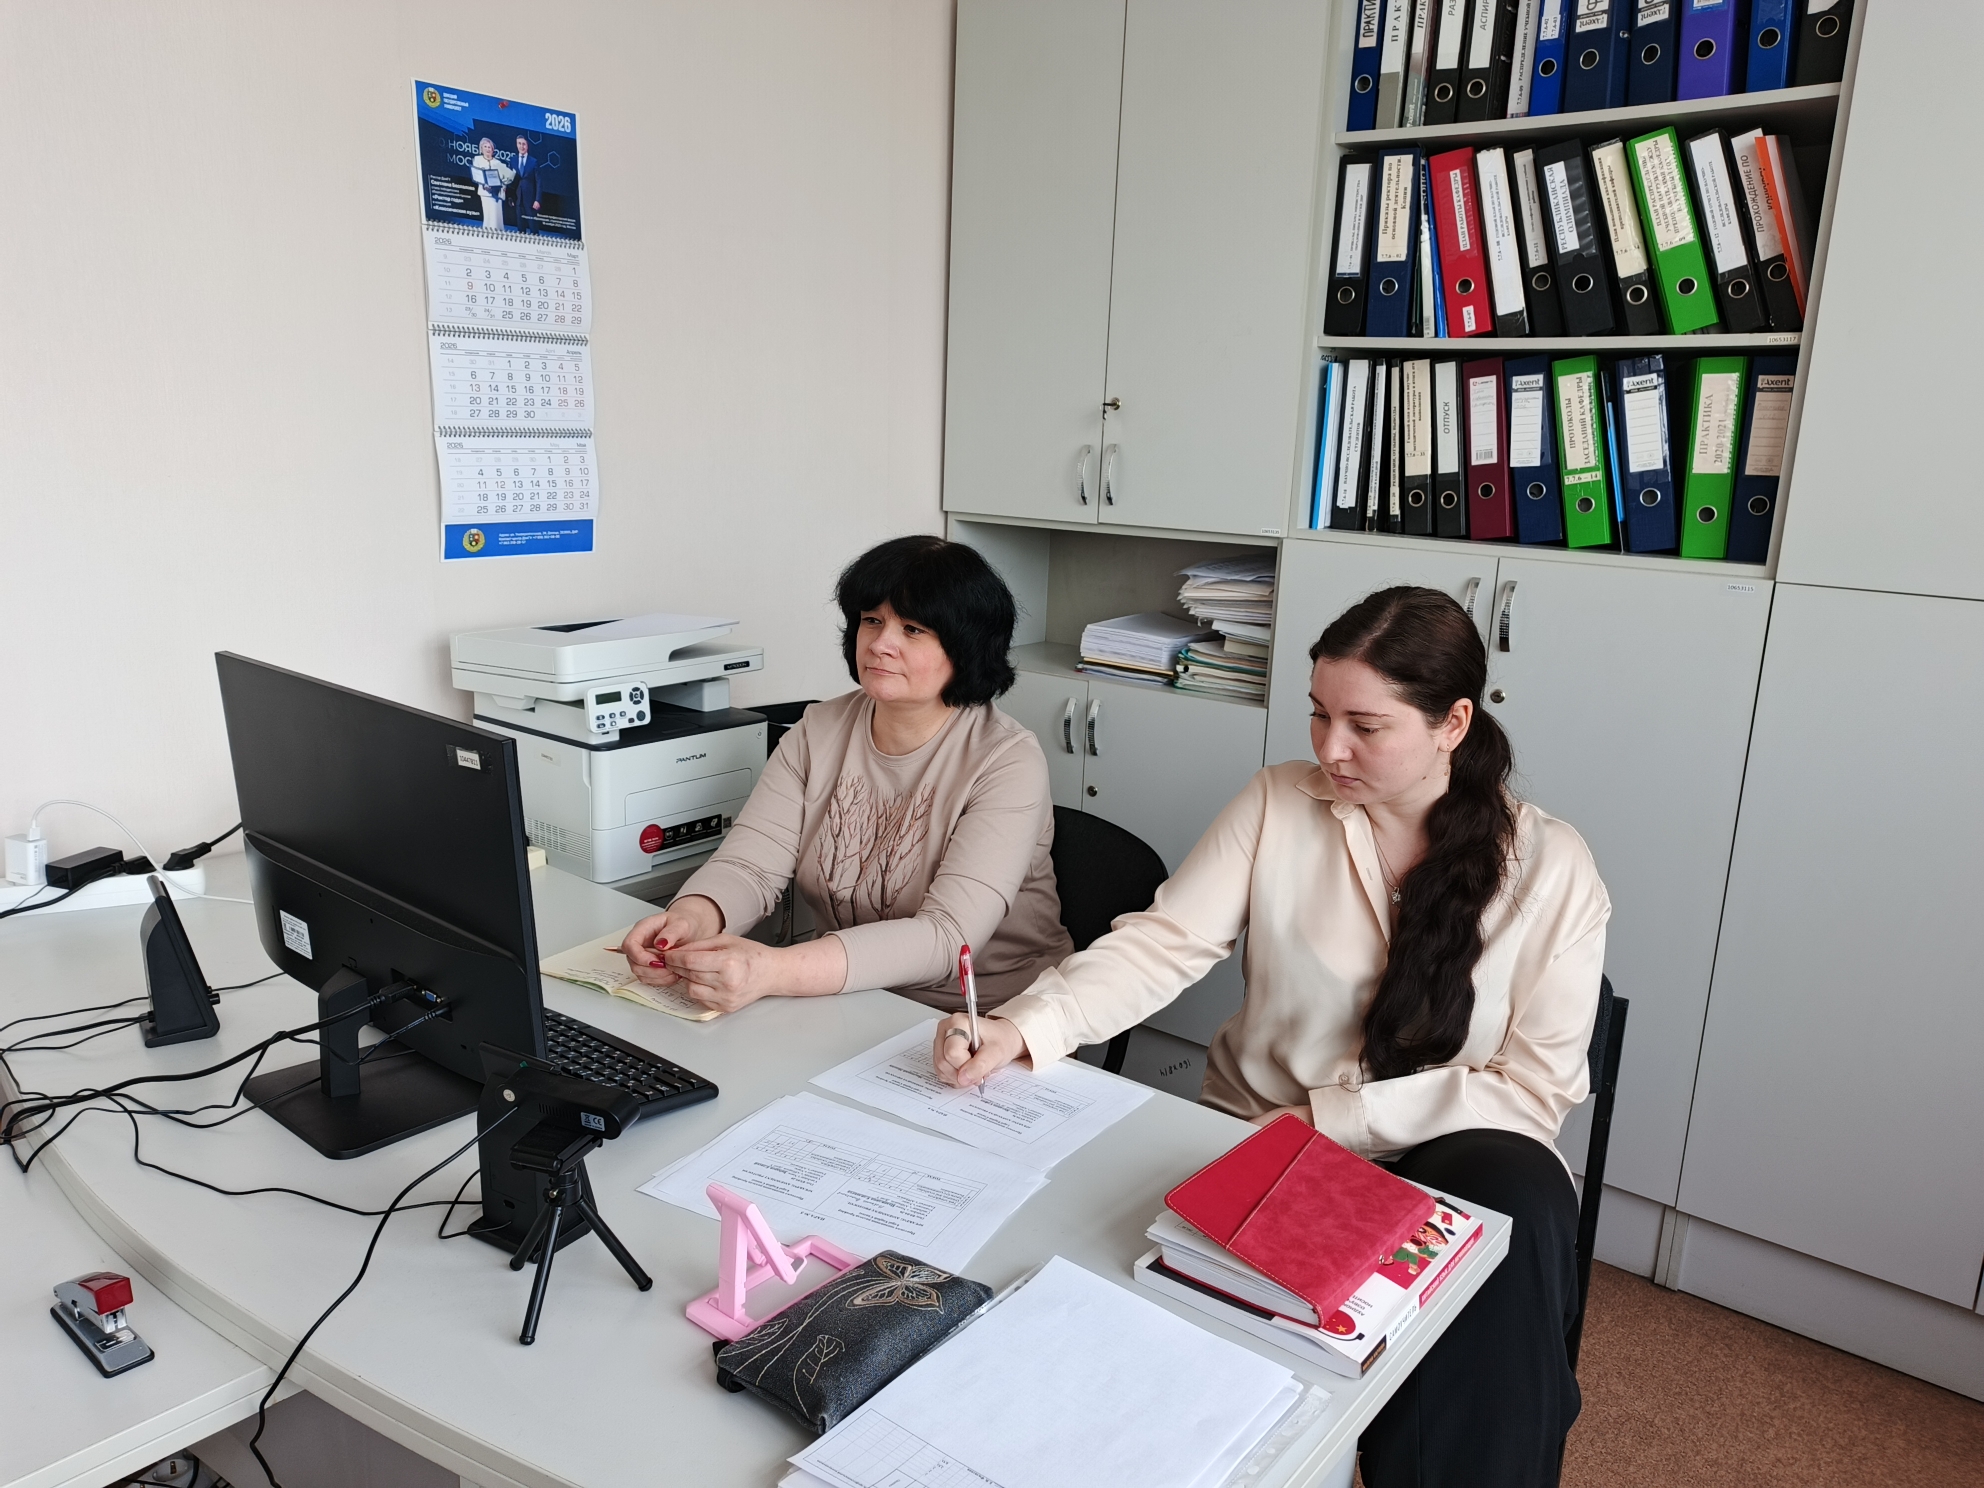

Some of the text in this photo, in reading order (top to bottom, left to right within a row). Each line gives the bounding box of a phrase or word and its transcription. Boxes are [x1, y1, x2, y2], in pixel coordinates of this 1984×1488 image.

[1519, 32, 1528, 81] РАСПРЕДЕЛЕНИЕ
[545, 113, 571, 132] 2026
[448, 139, 481, 155] НОЯБ
[1388, 163, 1392, 171] по
[1453, 173, 1462, 204] КАФЕДРЫ
[1741, 155, 1764, 232] ПРОХОЖДЕНИЕ ПО
[1457, 205, 1465, 230] РАБОТЫ
[1547, 167, 1567, 250] РЕСПУБЛИКАНСКАЯ
[1559, 179, 1574, 232] ОЛИМПИАДА
[466, 268, 472, 277] 2
[484, 284, 495, 292] 10
[520, 287, 530, 295] 12
[502, 311, 513, 319] 25
[520, 312, 531, 320] 26
[1630, 377, 1654, 387] Axent
[1565, 398, 1576, 449] ПРОТОКОЛЫ
[1576, 377, 1590, 465] ЗАСЕДАНИЙ КАФЕДРЫ
[1699, 394, 1714, 455] ПРАКТИКА
[1714, 419, 1726, 464] 2020-2021
[676, 753, 706, 763] PANTUM
